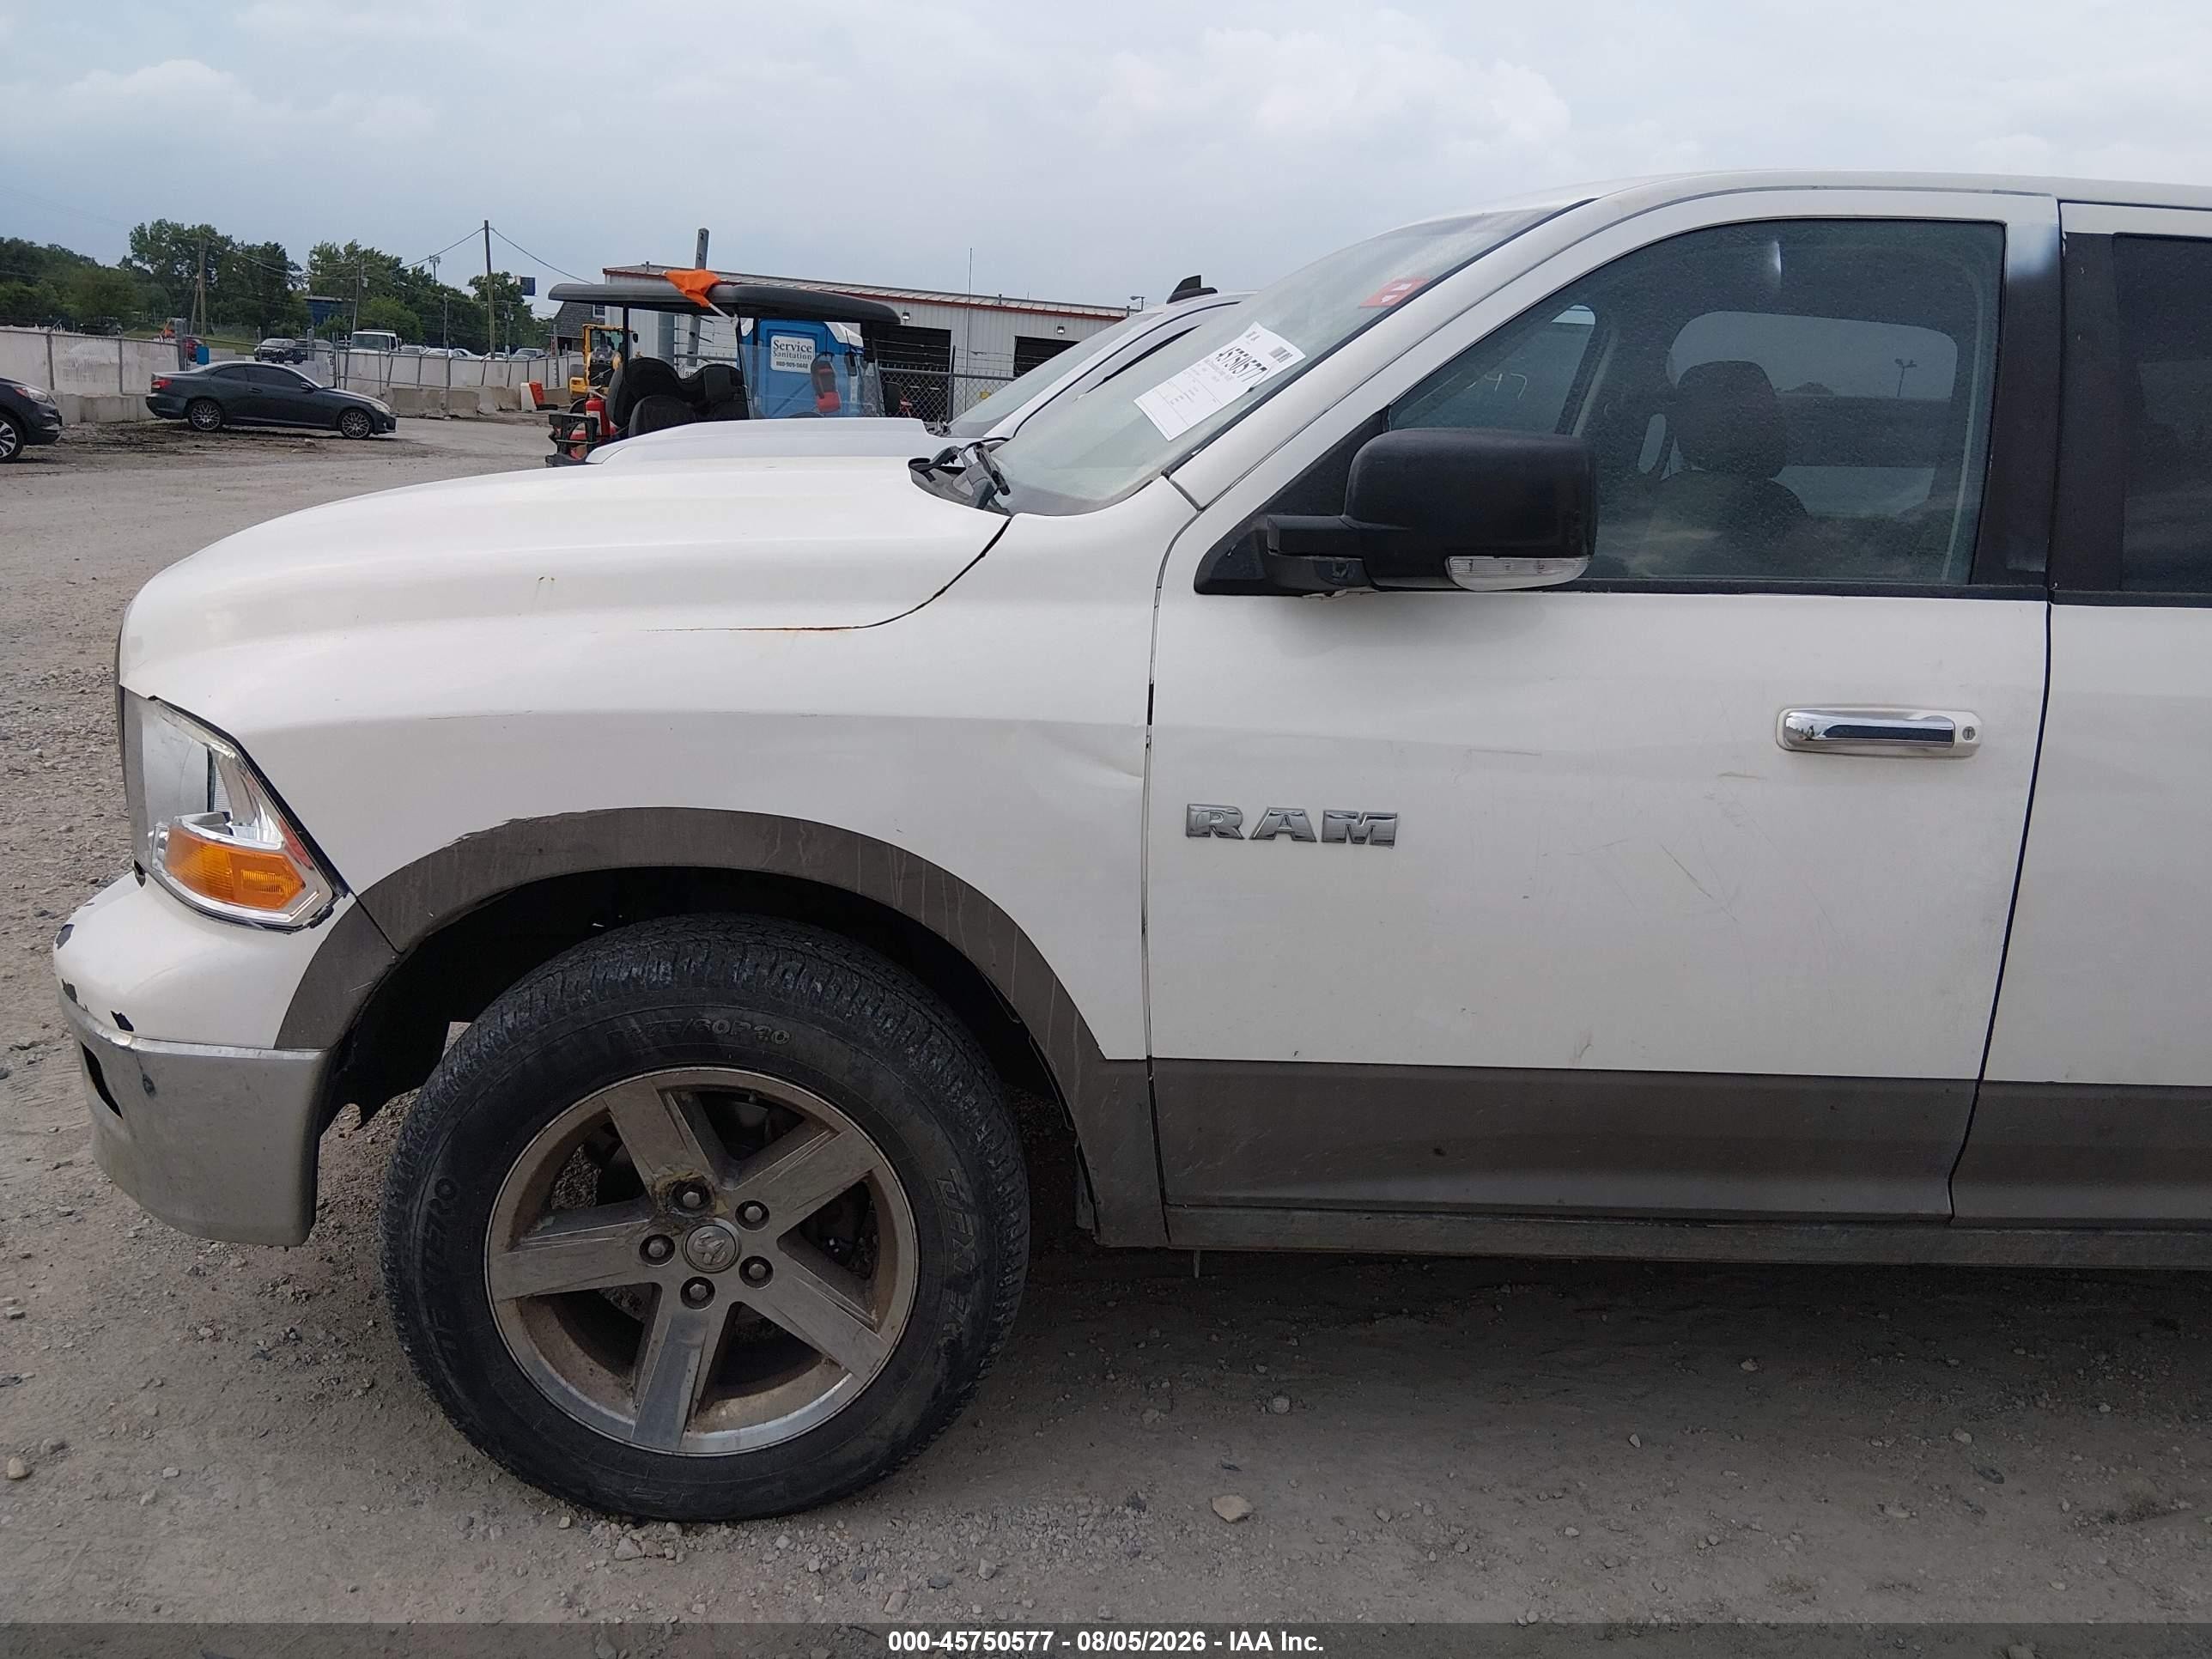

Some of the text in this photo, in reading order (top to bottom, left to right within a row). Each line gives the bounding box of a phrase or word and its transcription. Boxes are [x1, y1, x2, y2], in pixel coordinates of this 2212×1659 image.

[773, 339, 812, 352] Service
[773, 350, 812, 360] Sanitation
[1216, 346, 1267, 383] 45750577
[1186, 804, 1398, 847] RAM
